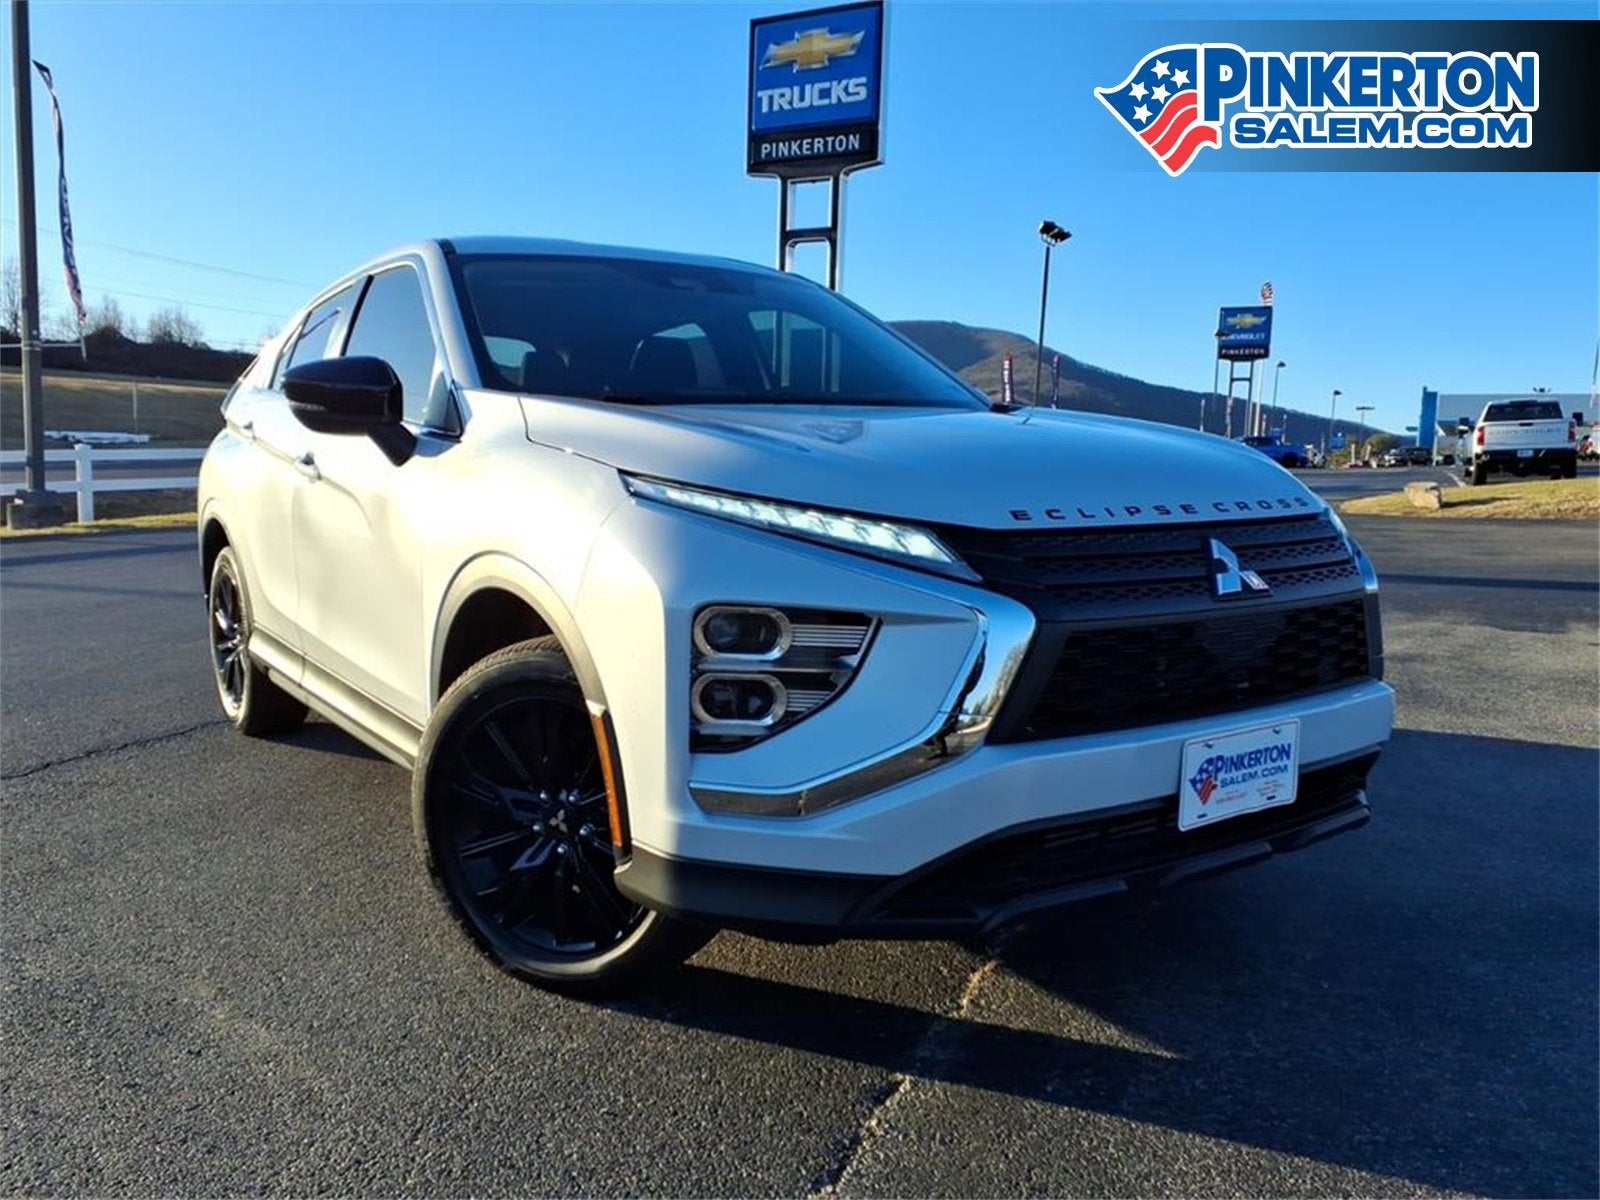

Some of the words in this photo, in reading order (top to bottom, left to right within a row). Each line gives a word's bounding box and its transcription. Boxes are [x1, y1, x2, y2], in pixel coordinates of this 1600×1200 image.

[757, 77, 867, 113] TRUCKS
[761, 134, 860, 158] PINKERTON
[1009, 504, 1200, 521] ECLIPSE
[1212, 497, 1309, 514] CROSS
[1214, 743, 1292, 781] PINKERTON
[1220, 765, 1288, 788] SALEM.COM
